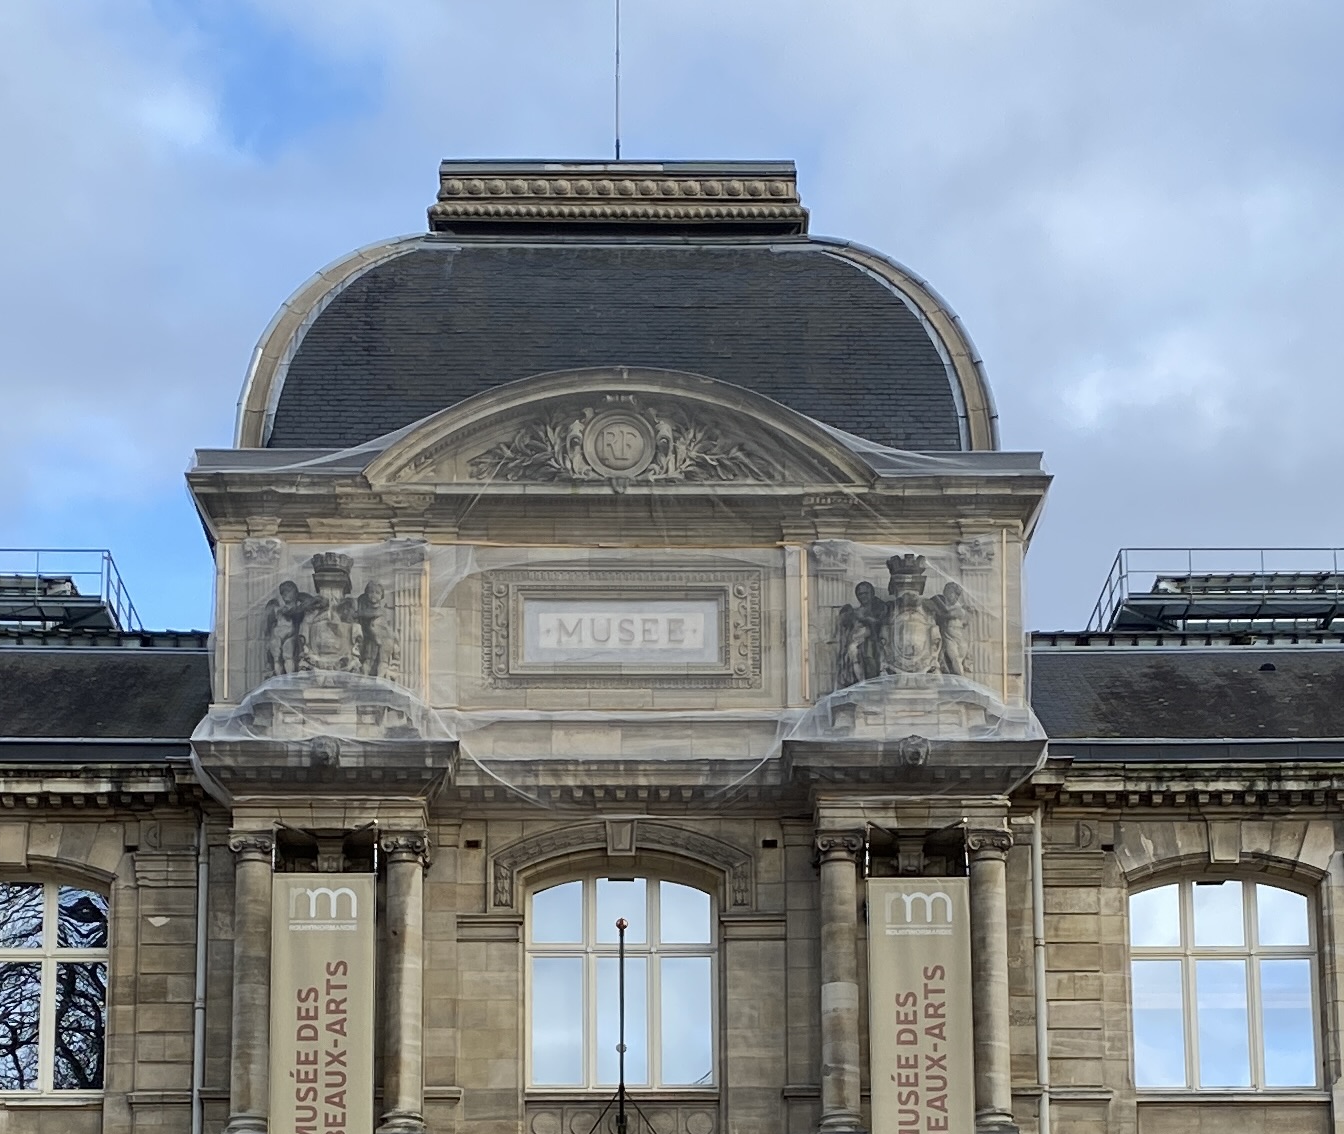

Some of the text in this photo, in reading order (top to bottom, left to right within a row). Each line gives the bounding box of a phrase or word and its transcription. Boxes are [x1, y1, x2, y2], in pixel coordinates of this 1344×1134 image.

[556, 618, 685, 645] MUSEE
[296, 987, 319, 1042] DES
[895, 991, 918, 1046] DES
